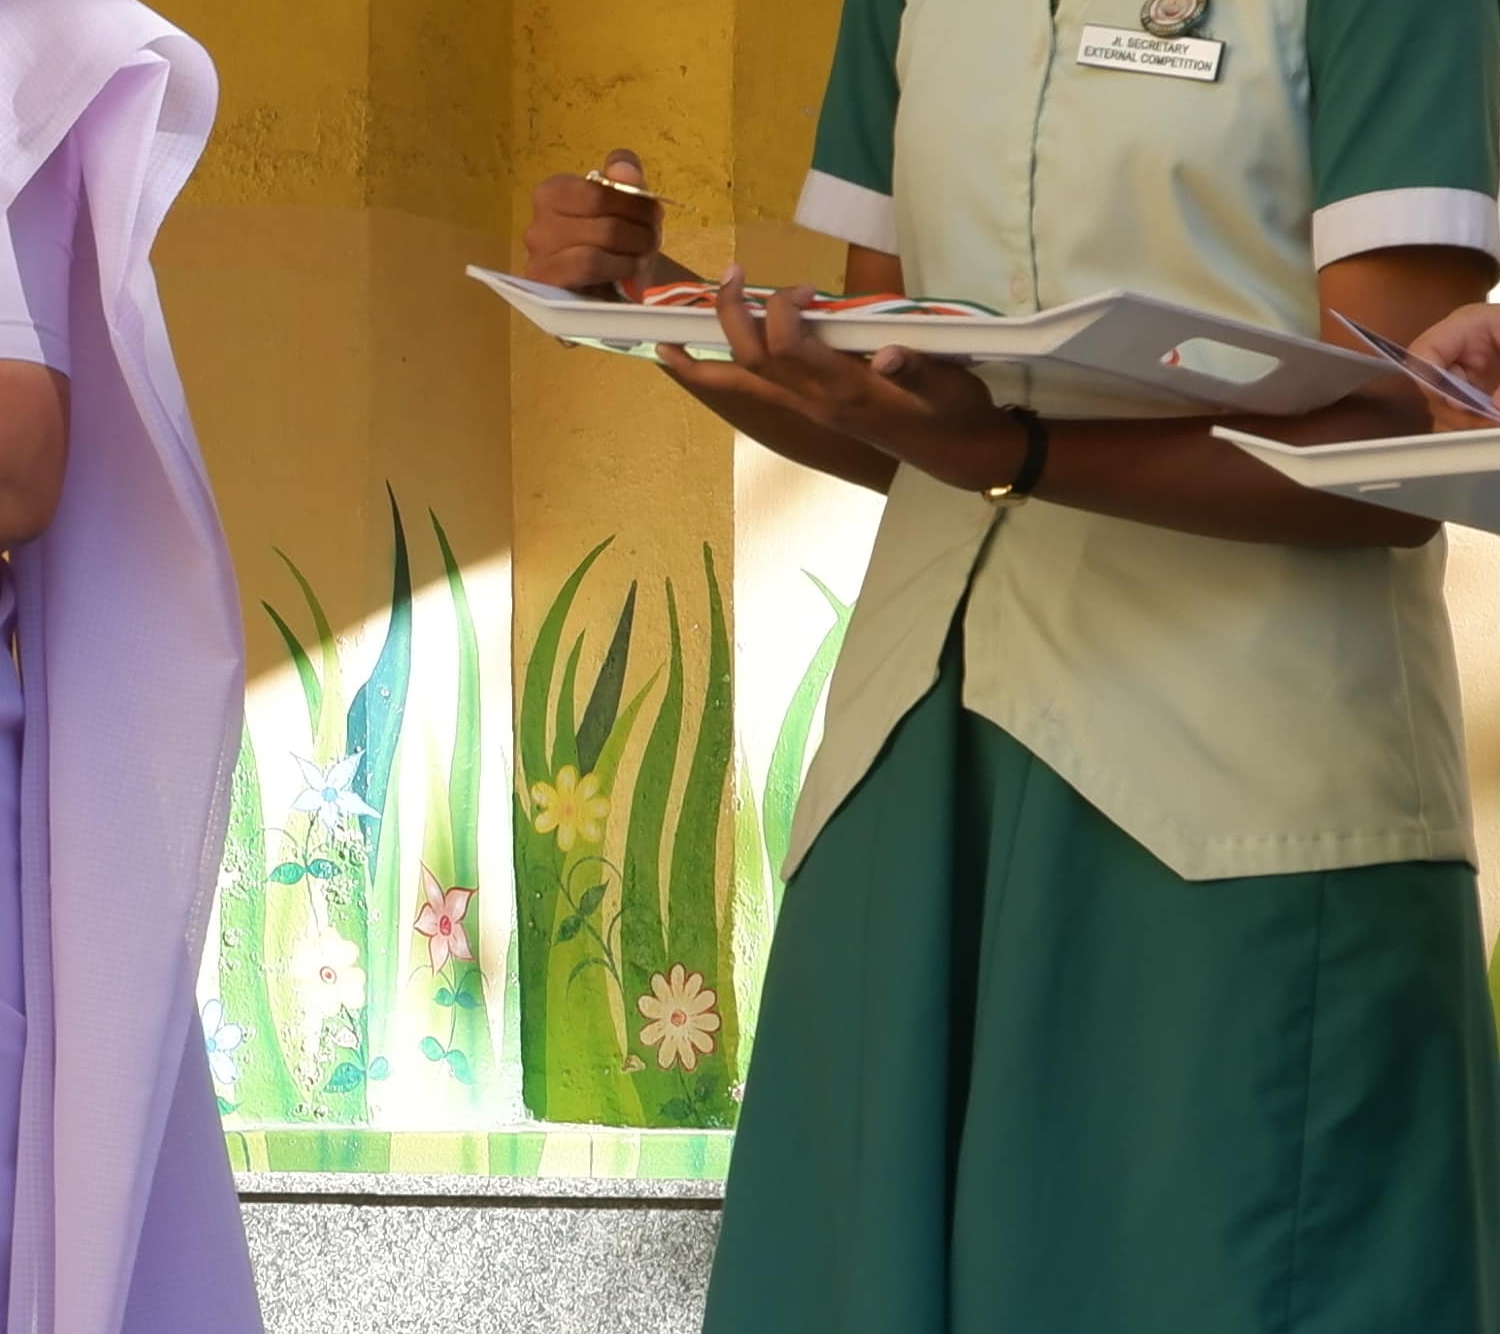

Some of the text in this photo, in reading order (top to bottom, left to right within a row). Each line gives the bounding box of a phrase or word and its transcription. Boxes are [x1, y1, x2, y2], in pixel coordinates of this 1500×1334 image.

[1127, 37, 1190, 55] SECRETARY
[1084, 46, 1213, 71] EXTERNAL COMPETITION
